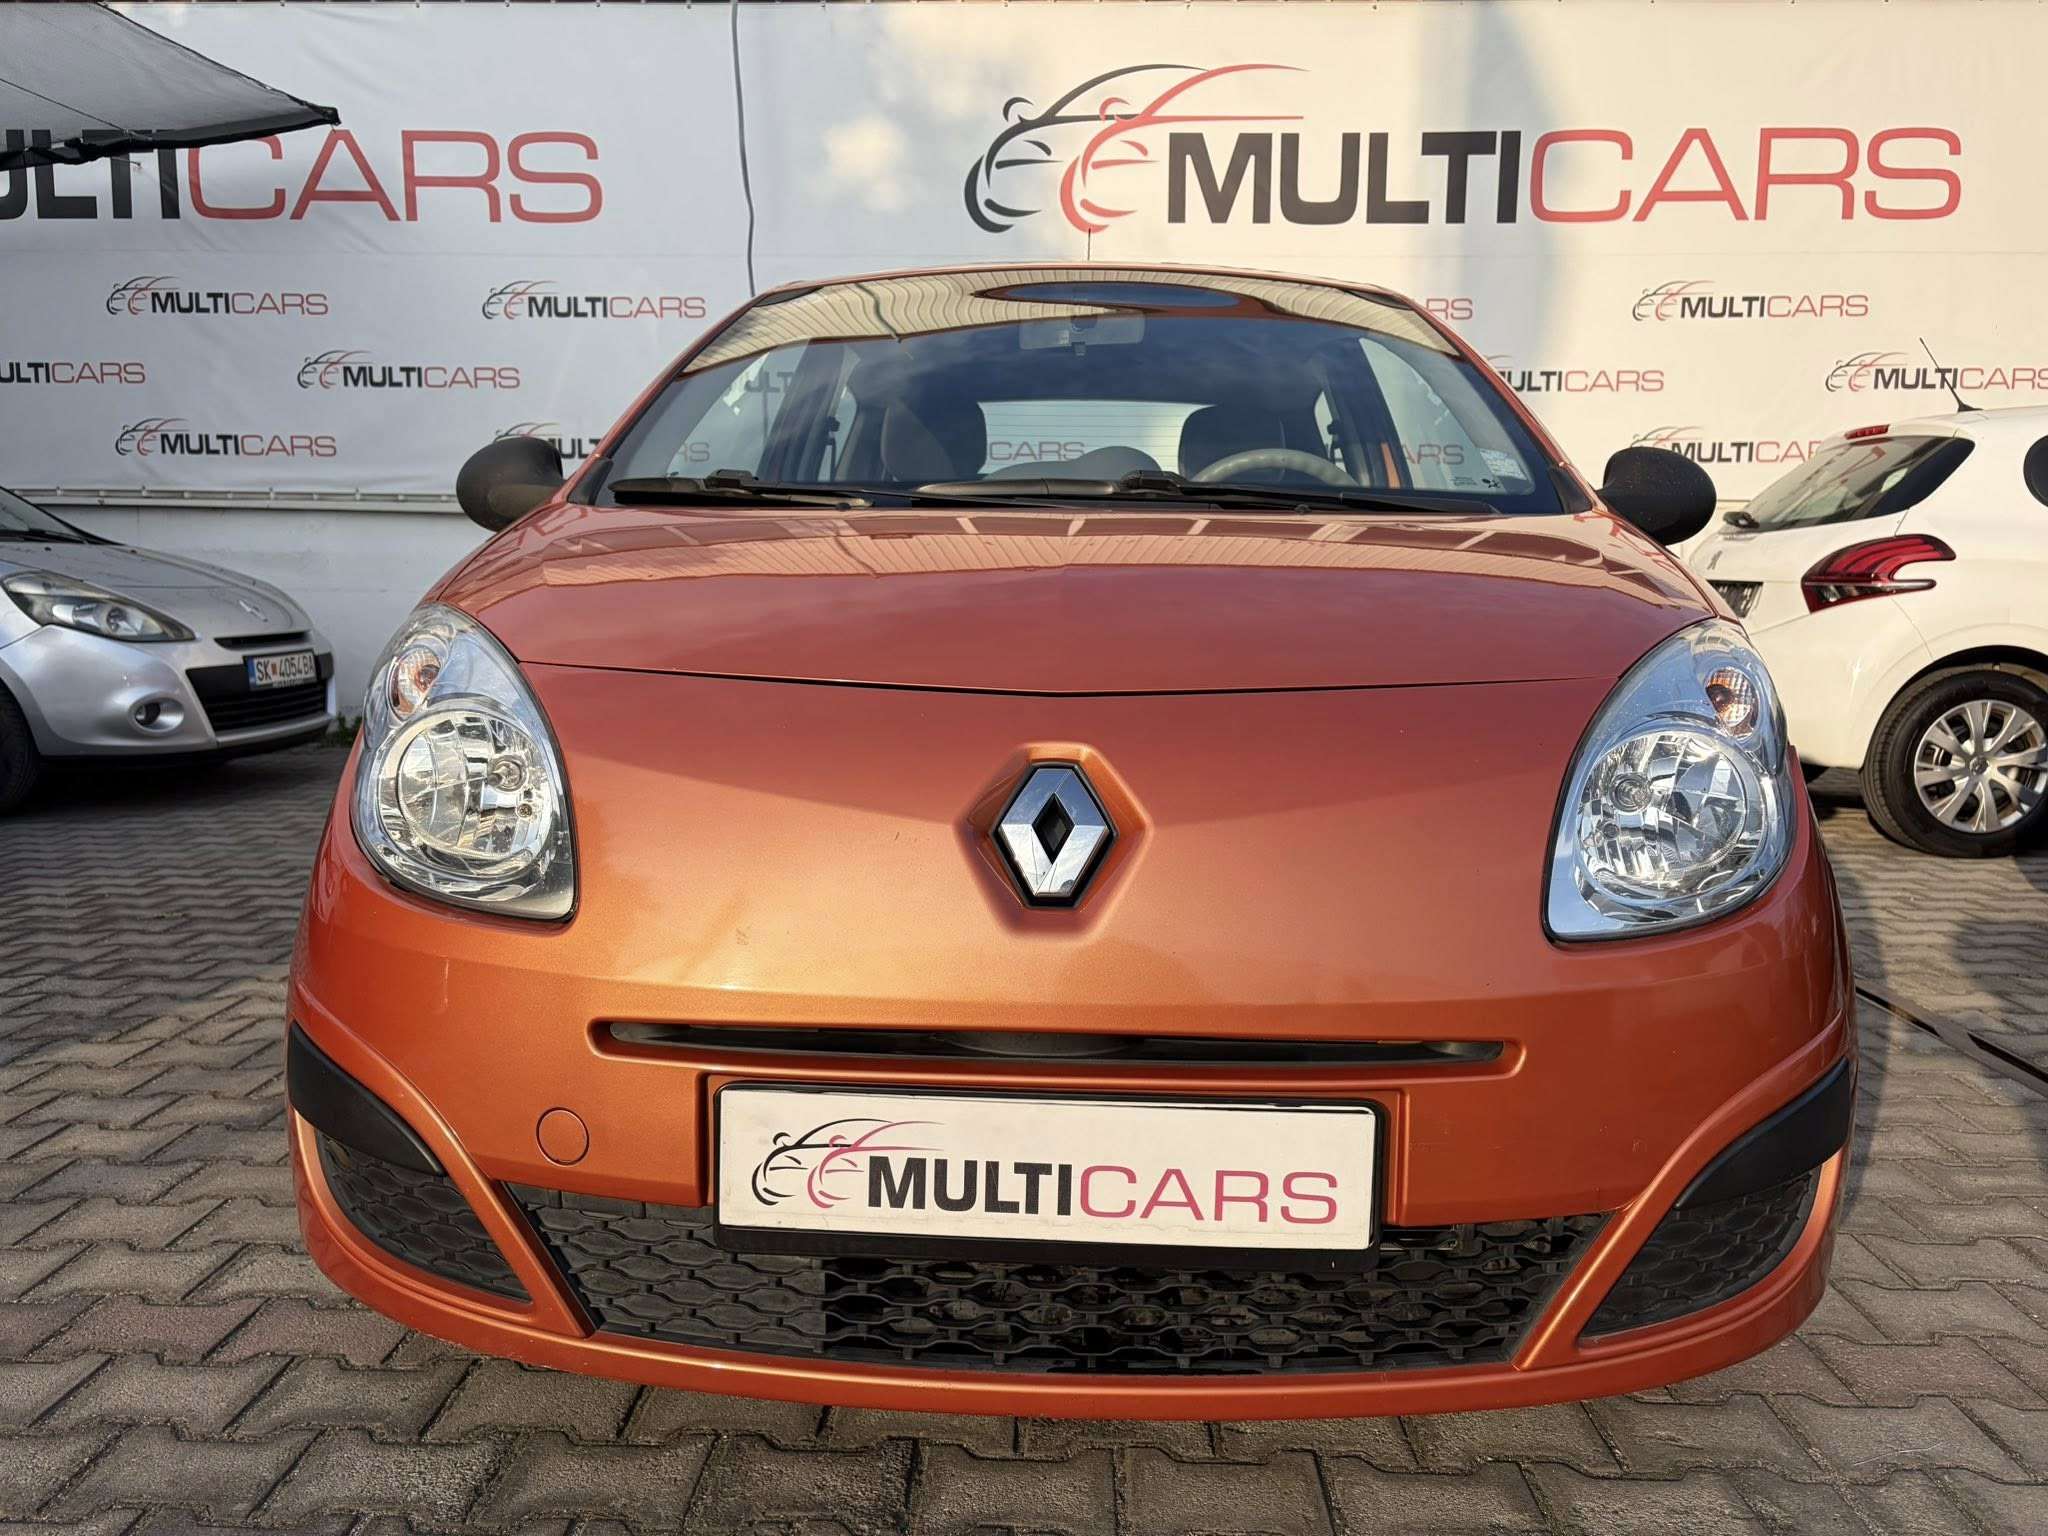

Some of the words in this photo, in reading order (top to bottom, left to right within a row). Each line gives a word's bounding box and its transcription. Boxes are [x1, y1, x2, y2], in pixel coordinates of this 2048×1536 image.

[0, 129, 603, 224] LTICARS
[1167, 127, 1963, 226] MULTICARS
[150, 291, 329, 317] MULTICARS
[527, 295, 707, 321] MULTICARS
[1680, 294, 1869, 320] MULTICARS
[0, 361, 146, 384] ULTICARS
[342, 364, 521, 390] MULTICARS
[159, 432, 338, 458] MULTICARS
[867, 1156, 1339, 1225] MULTICARS
